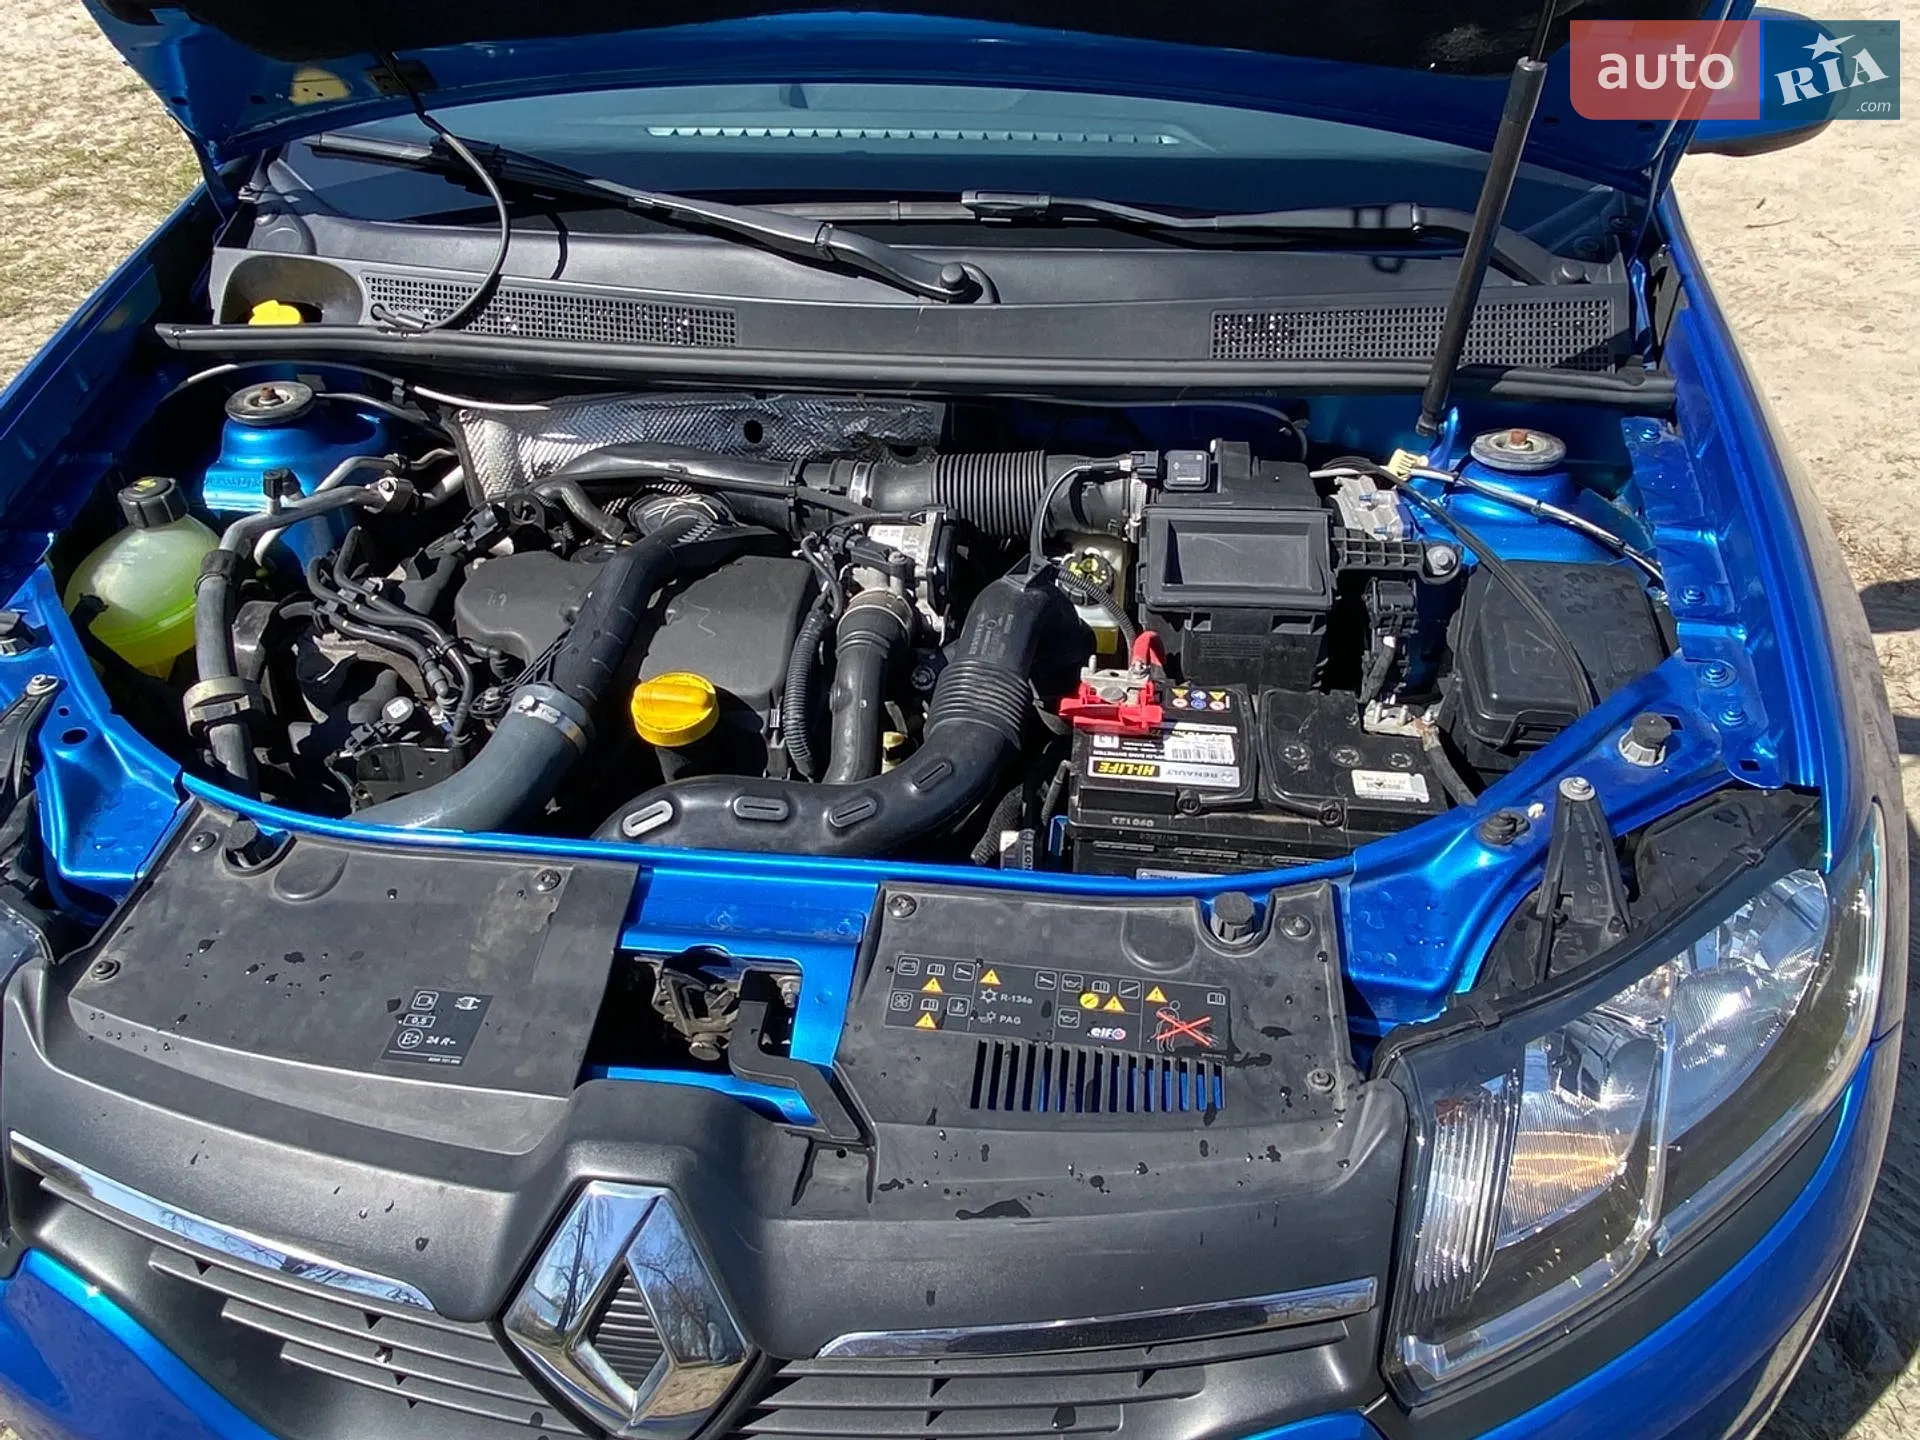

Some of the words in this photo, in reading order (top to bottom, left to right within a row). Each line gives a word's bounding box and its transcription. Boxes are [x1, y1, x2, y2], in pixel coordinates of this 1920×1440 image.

[1166, 769, 1219, 780] RENAULT
[1000, 993, 1033, 1005] R-134a
[1000, 1014, 1022, 1026] PAG
